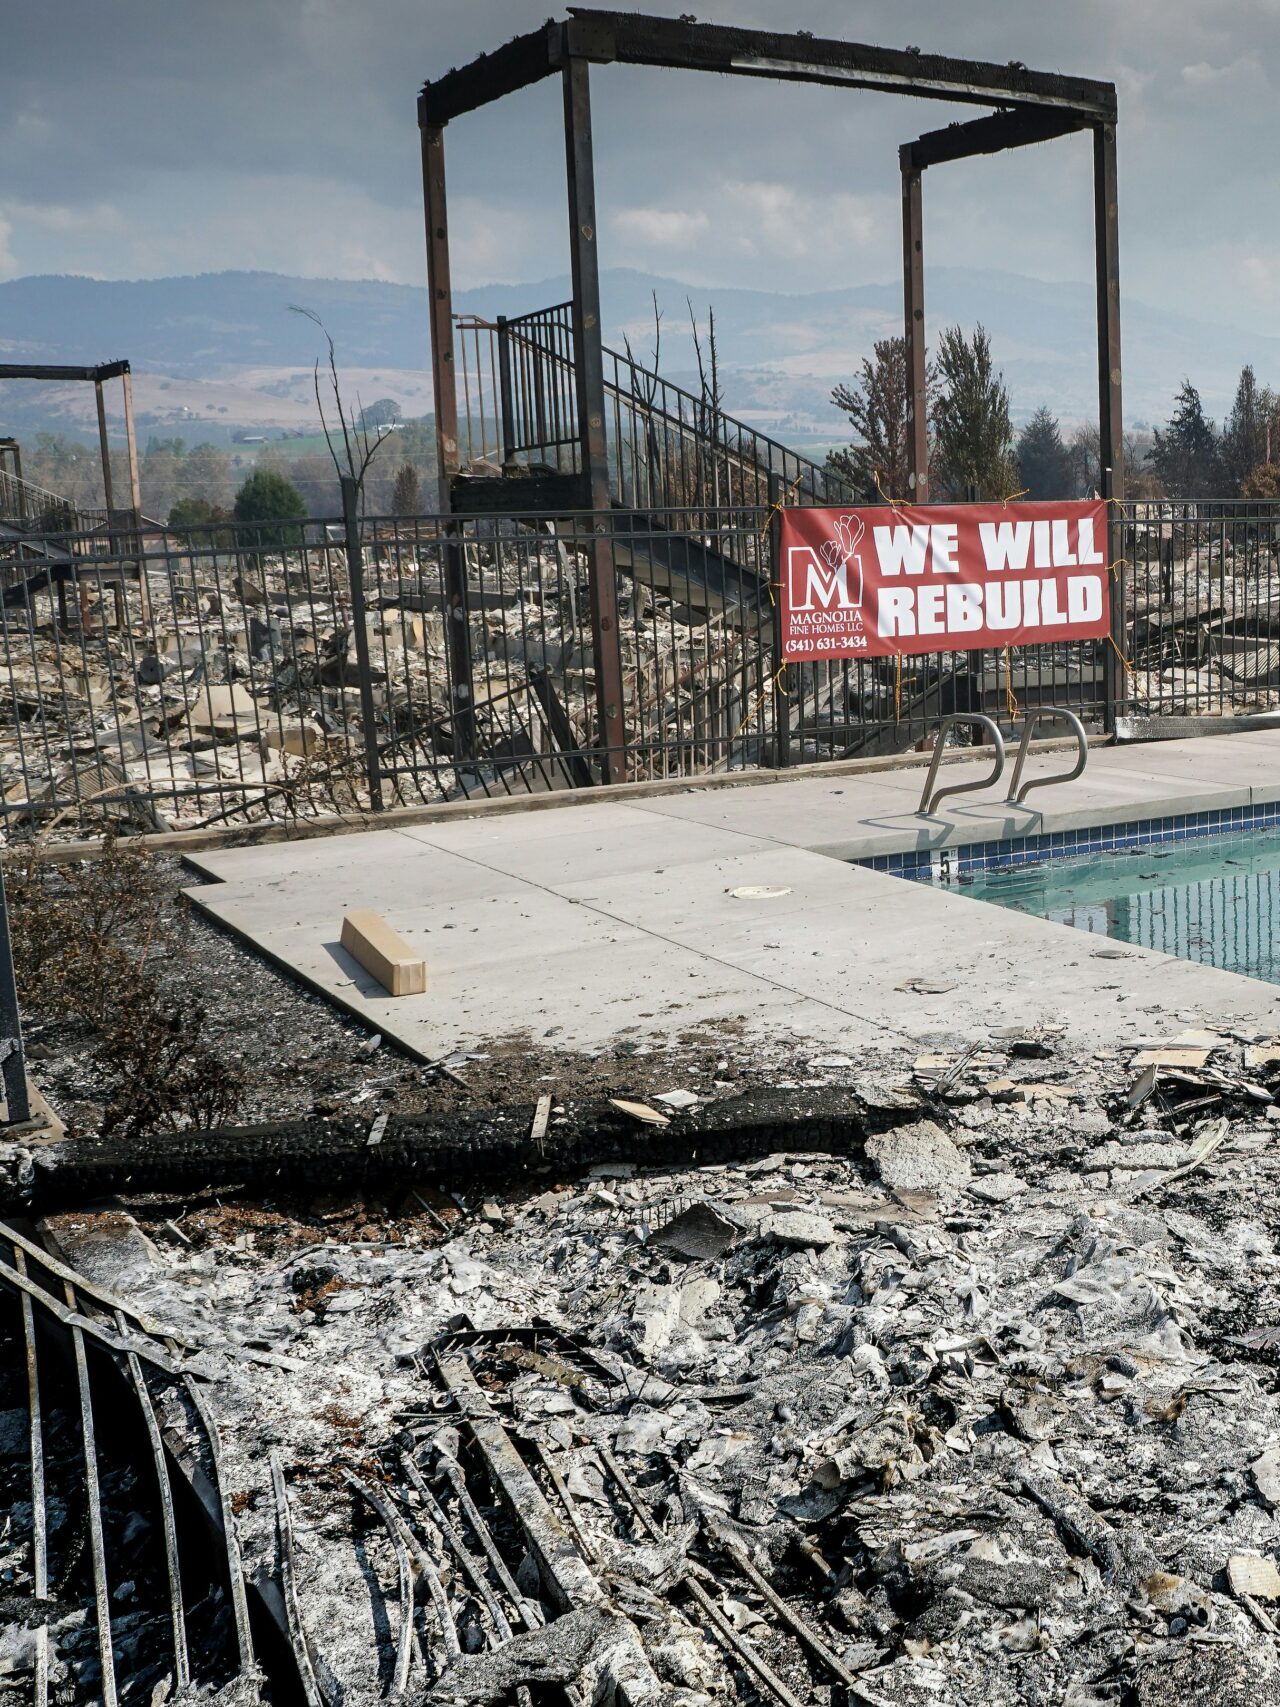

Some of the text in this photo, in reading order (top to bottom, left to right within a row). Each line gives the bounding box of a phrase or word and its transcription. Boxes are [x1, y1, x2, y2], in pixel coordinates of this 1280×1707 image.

[873, 518, 1103, 576] WE WILL
[877, 575, 1103, 638] REBUILD
[790, 610, 862, 625] MAGNOLIA
[790, 622, 863, 635] FINE HOMES LLC
[786, 636, 867, 653] (541) 631-3434
